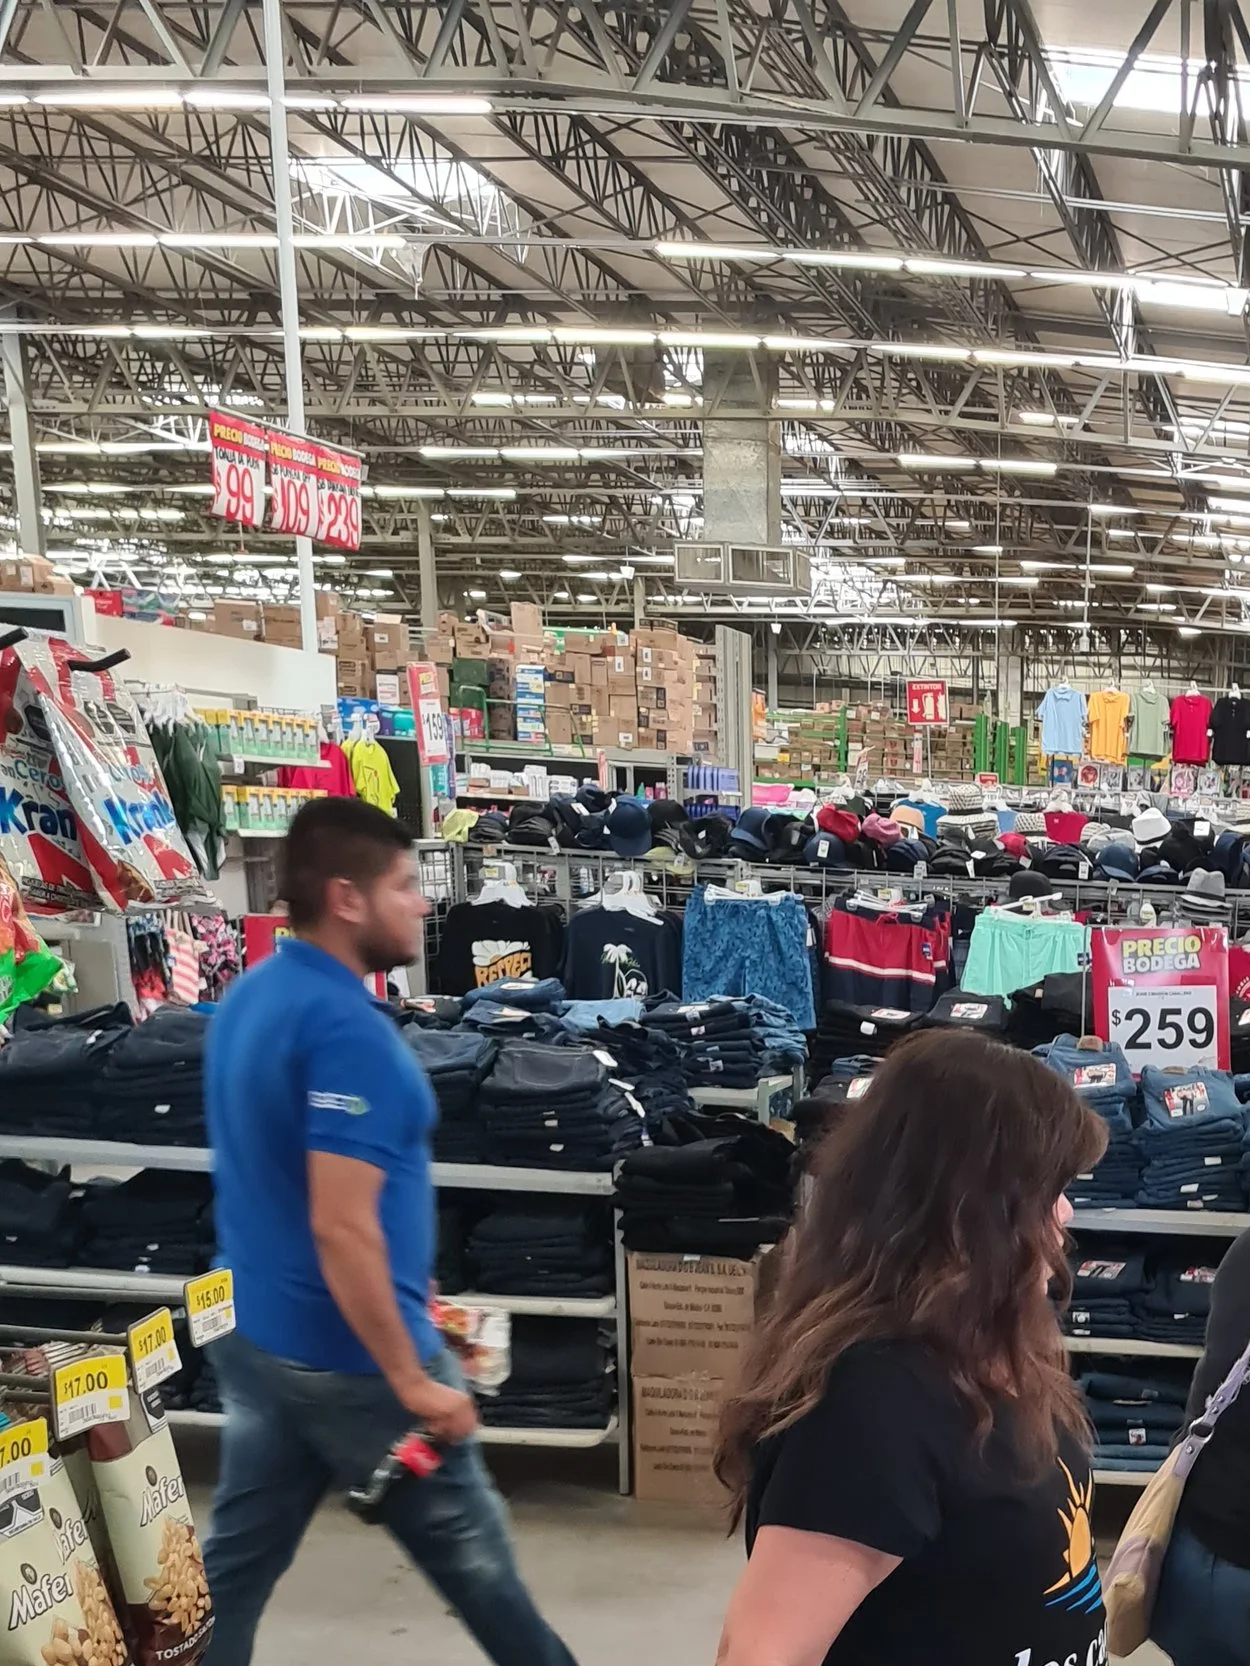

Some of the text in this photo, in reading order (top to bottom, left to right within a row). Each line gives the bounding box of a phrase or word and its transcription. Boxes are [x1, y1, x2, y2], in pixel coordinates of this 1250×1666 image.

[1122, 935, 1202, 957] PRECIO
[1123, 954, 1200, 975] BODEGA
[1111, 1007, 1214, 1050] $259
[196, 1285, 225, 1309] $15.00
[138, 1326, 166, 1355] $17.00
[64, 1371, 108, 1398] $17.00
[8, 1572, 73, 1632] Mafer
